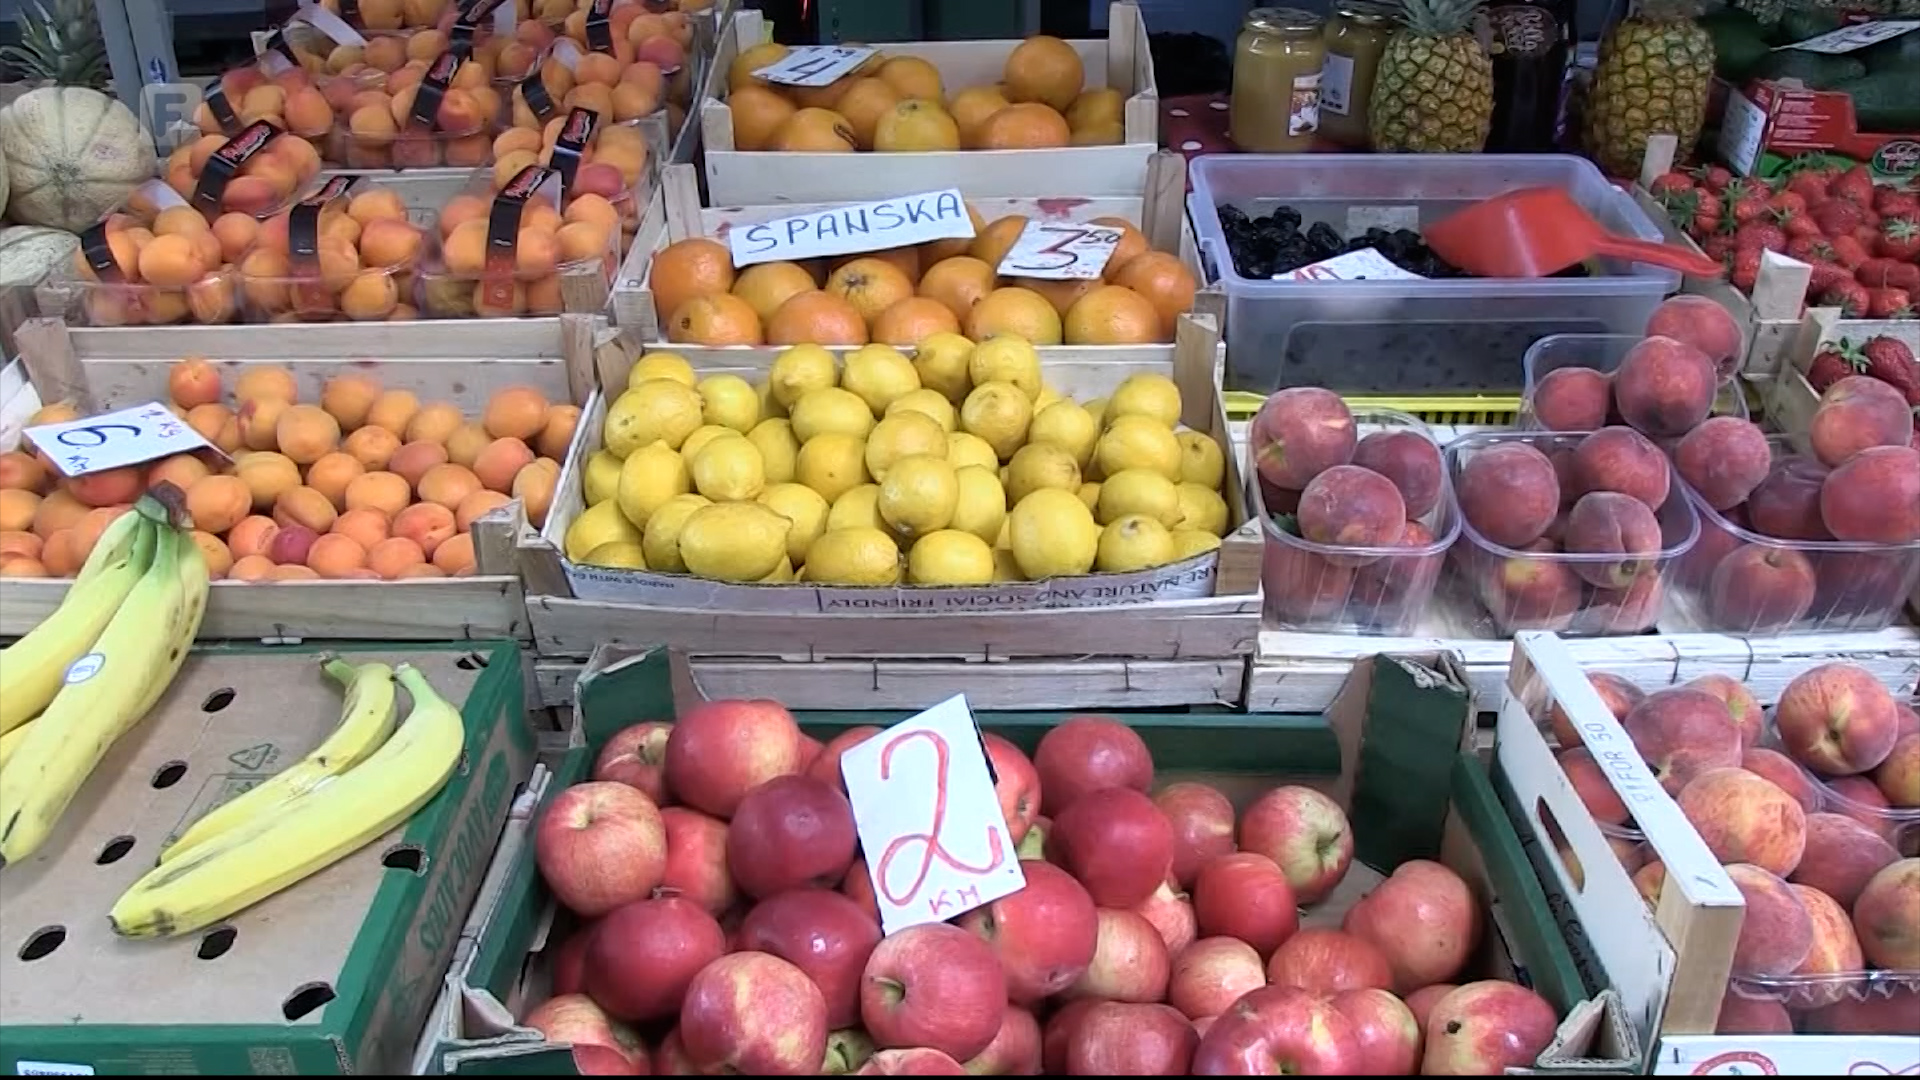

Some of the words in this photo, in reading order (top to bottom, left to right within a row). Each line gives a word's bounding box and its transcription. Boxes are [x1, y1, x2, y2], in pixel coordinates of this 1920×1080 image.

[785, 57, 839, 82] 4
[746, 192, 961, 254] SPANSKA
[1012, 226, 1089, 270] 3
[57, 424, 142, 447] 6
[1036, 588, 1086, 600] AND
[1094, 576, 1181, 597] NATURE
[827, 598, 935, 609] FRIENDLY
[946, 594, 1028, 606] SOCIAL
[1583, 722, 1613, 741] 50
[876, 728, 1005, 908] 2
